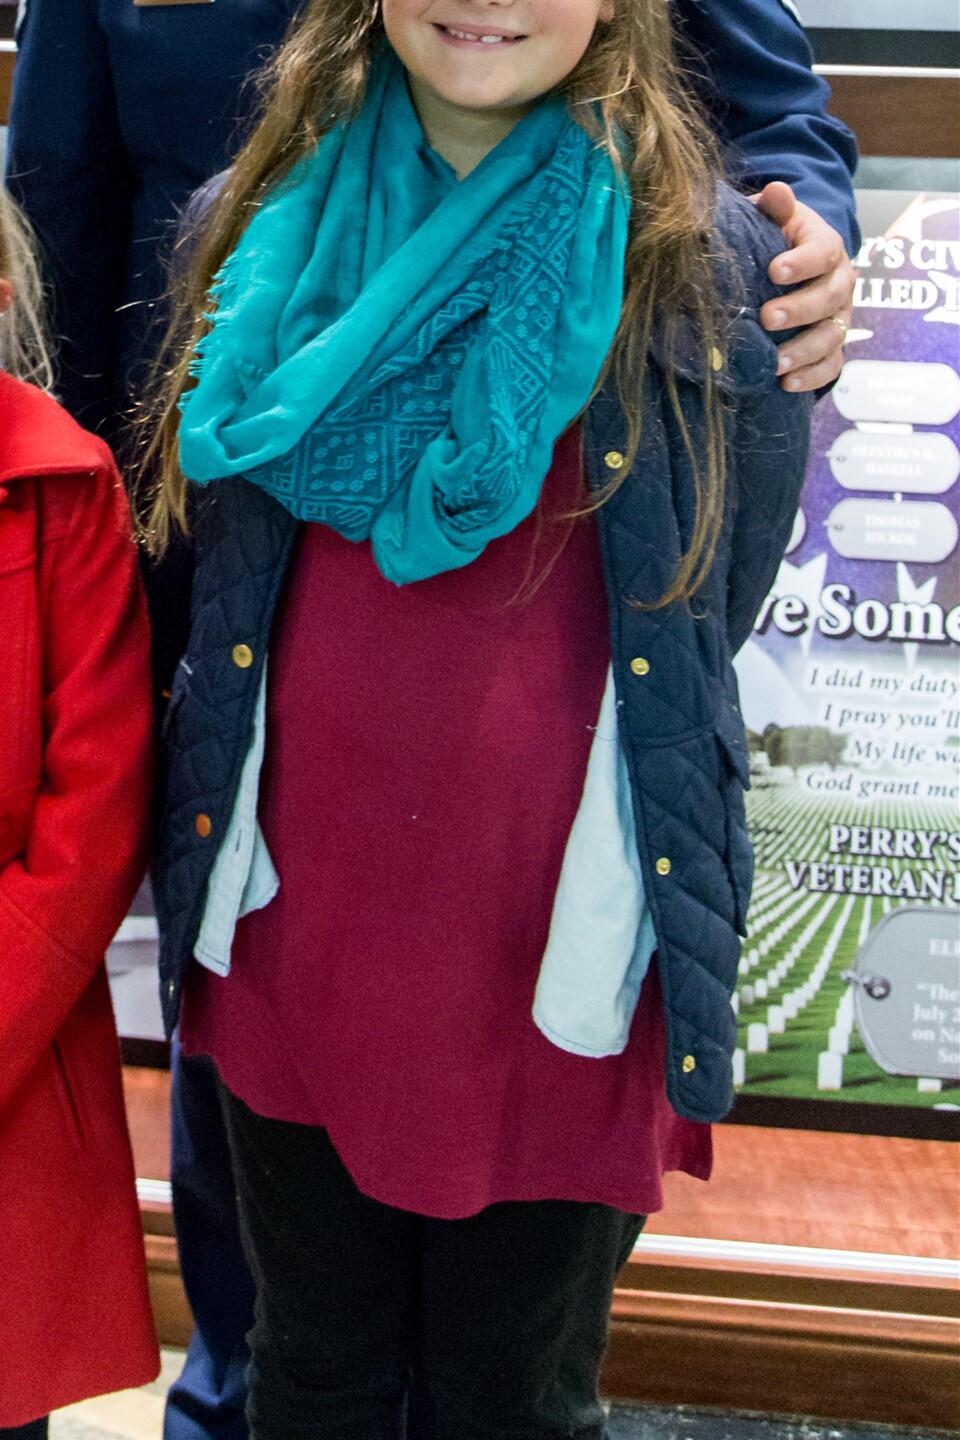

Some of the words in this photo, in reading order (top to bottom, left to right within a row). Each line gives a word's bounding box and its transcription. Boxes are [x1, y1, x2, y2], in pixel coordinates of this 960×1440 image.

[852, 277, 938, 310] LLED
[810, 668, 818, 686] I
[825, 668, 863, 688] did
[870, 675, 903, 695] my
[824, 703, 832, 721] I
[838, 709, 890, 728] pray
[851, 740, 885, 764] My
[892, 741, 927, 765] life
[806, 771, 853, 791] God
[857, 779, 920, 798] grant
[829, 823, 960, 861] PERRY'S
[784, 860, 945, 900] VETERAN
[913, 1003, 949, 1025] July
